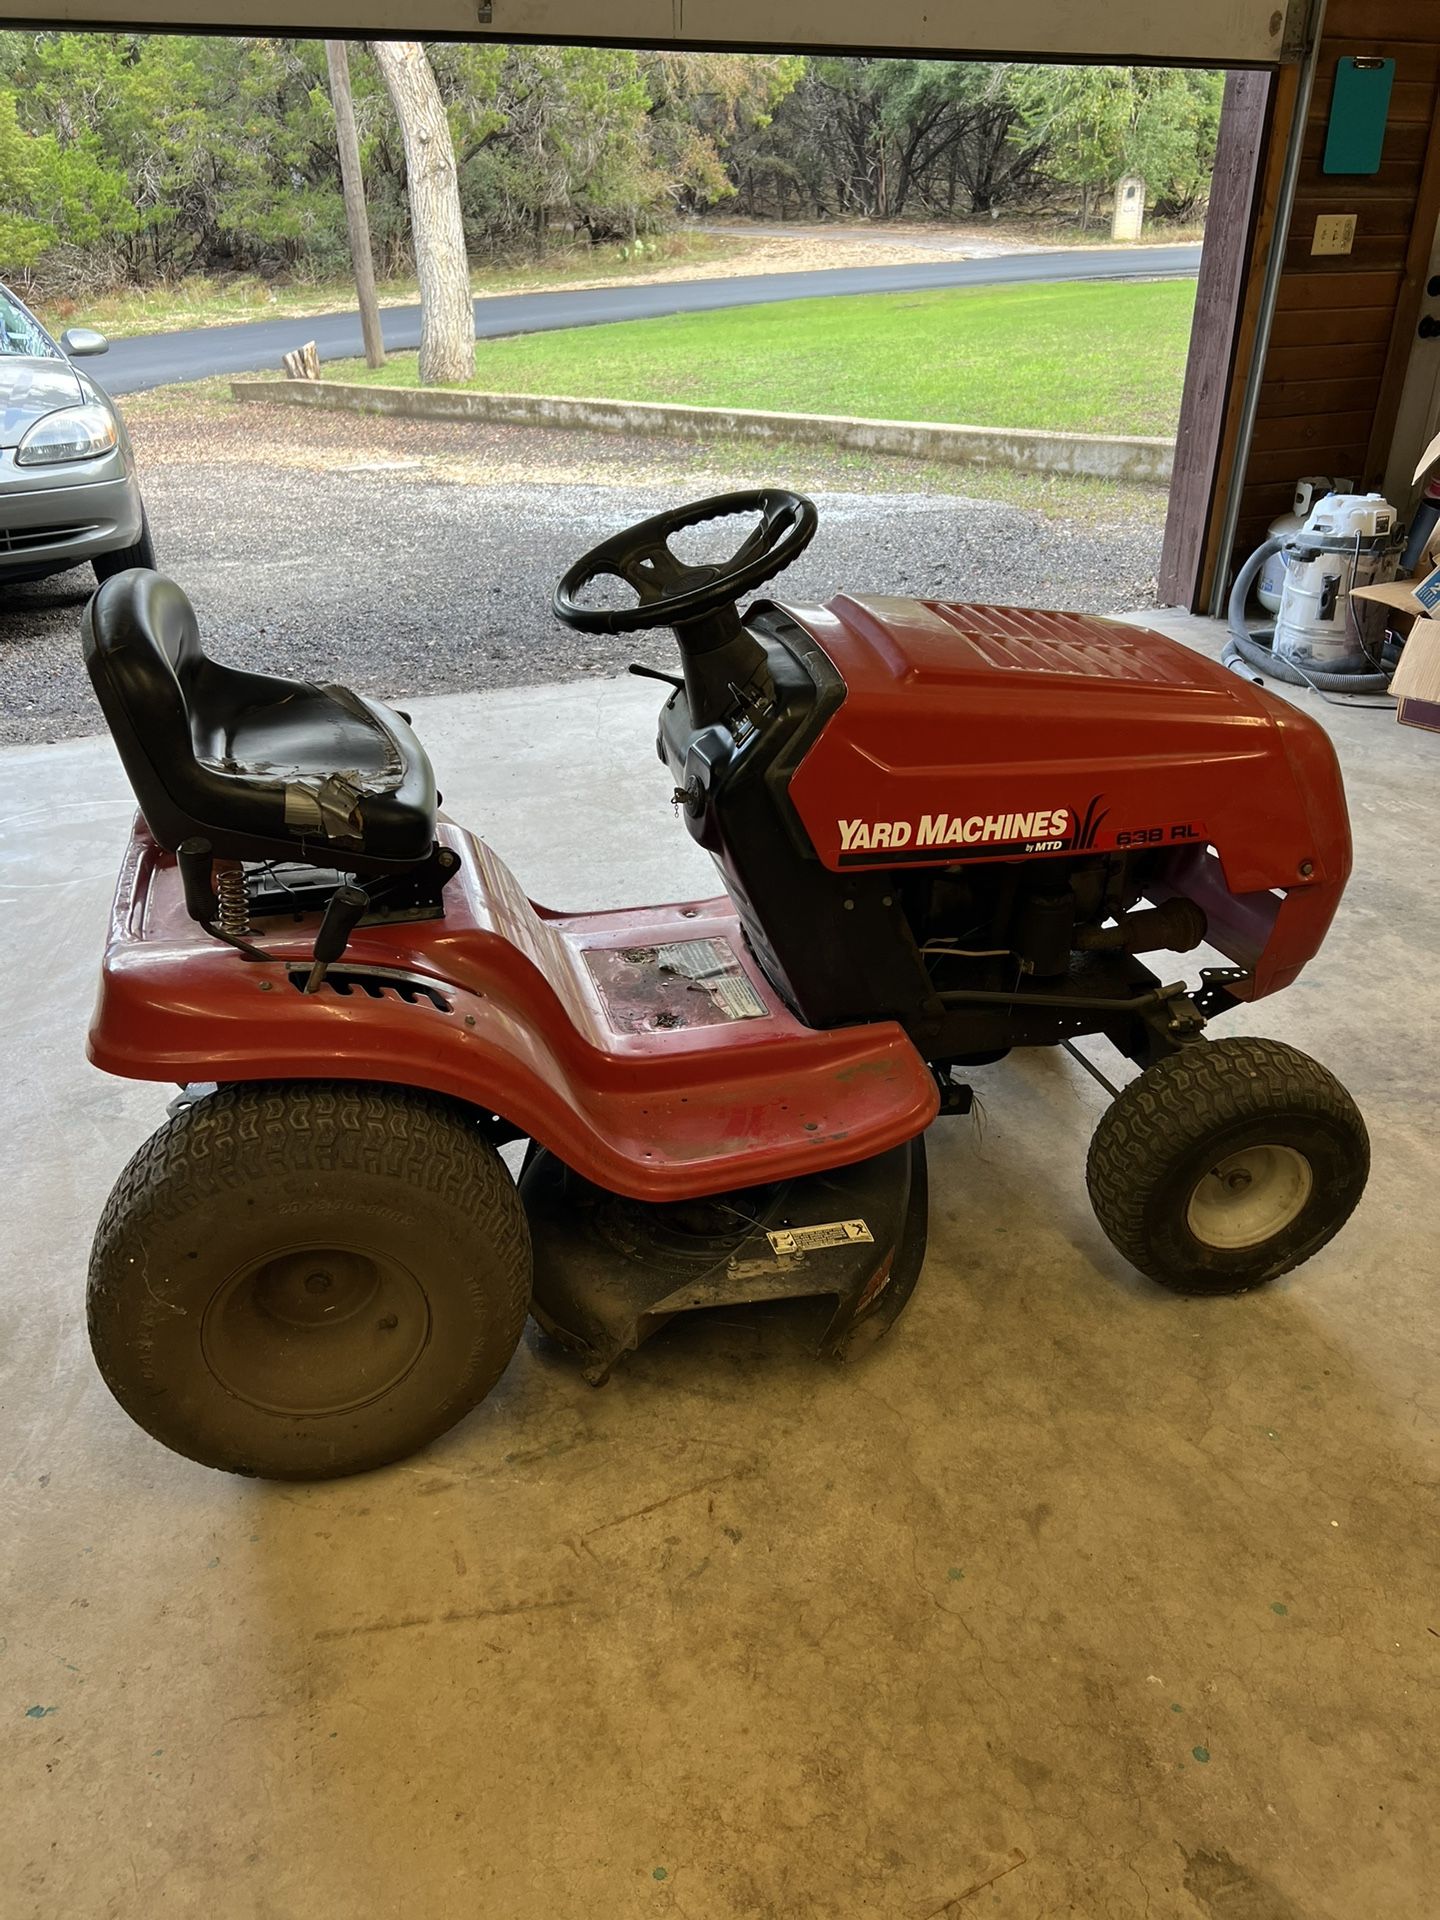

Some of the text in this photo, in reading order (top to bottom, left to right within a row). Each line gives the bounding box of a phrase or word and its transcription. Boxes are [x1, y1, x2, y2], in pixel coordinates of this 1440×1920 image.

[838, 809, 1068, 850] YARD MACHINES
[1116, 824, 1199, 845] 638 RL
[1025, 841, 1062, 853] by MTD
